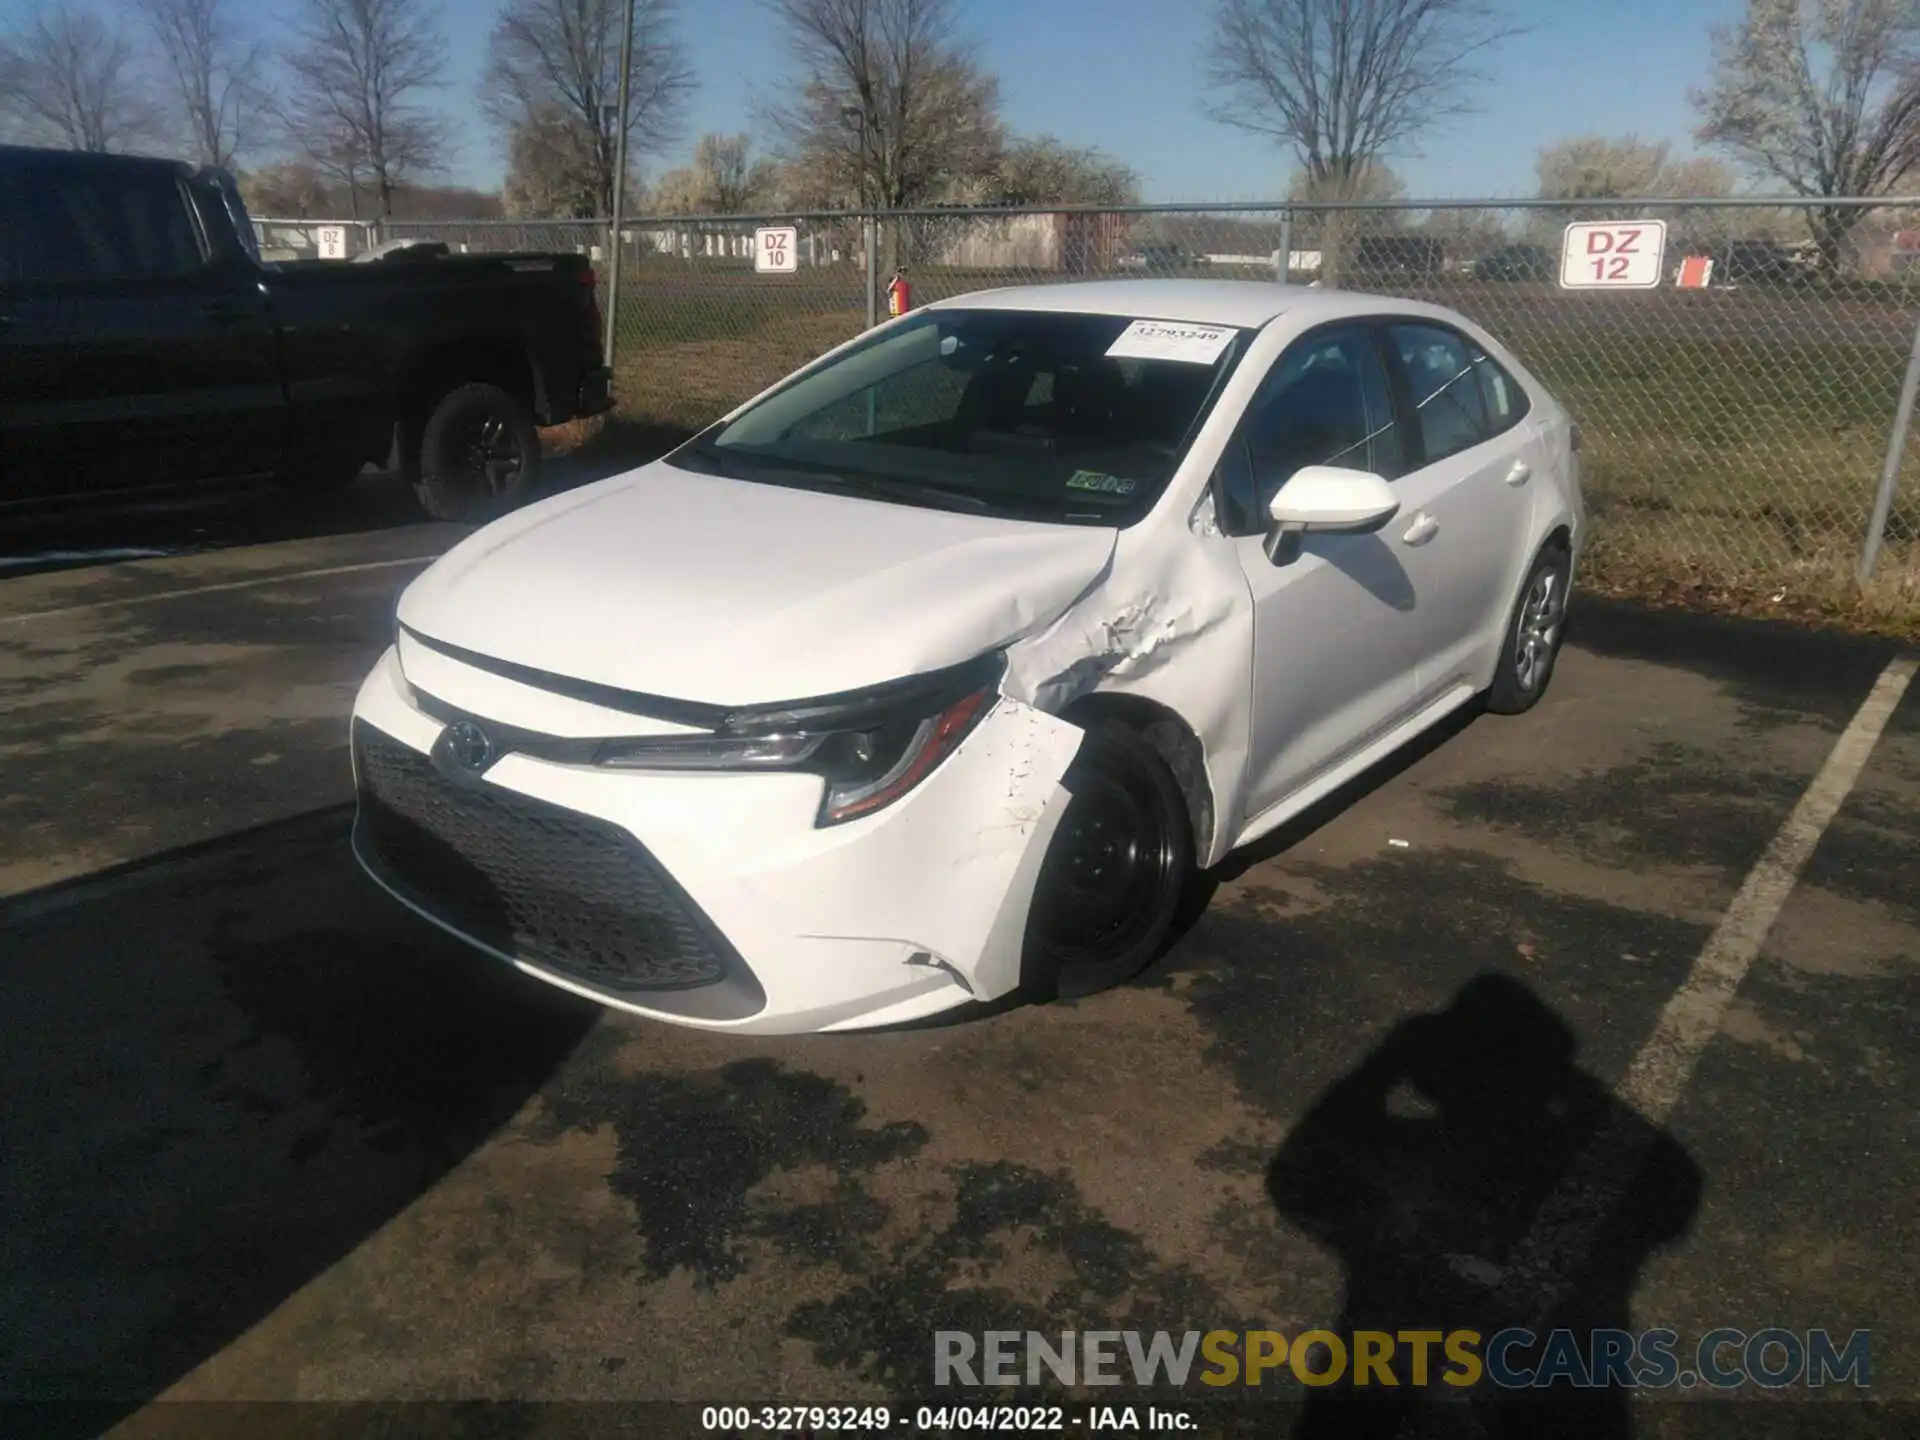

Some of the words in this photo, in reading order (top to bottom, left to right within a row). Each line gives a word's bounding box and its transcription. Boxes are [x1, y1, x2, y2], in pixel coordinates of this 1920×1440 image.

[323, 230, 339, 243] DZ
[764, 233, 787, 250] DZ
[1586, 229, 1642, 255] DZ
[767, 250, 785, 266] 10
[1590, 256, 1631, 280] 12
[1137, 326, 1220, 341] 32793249
